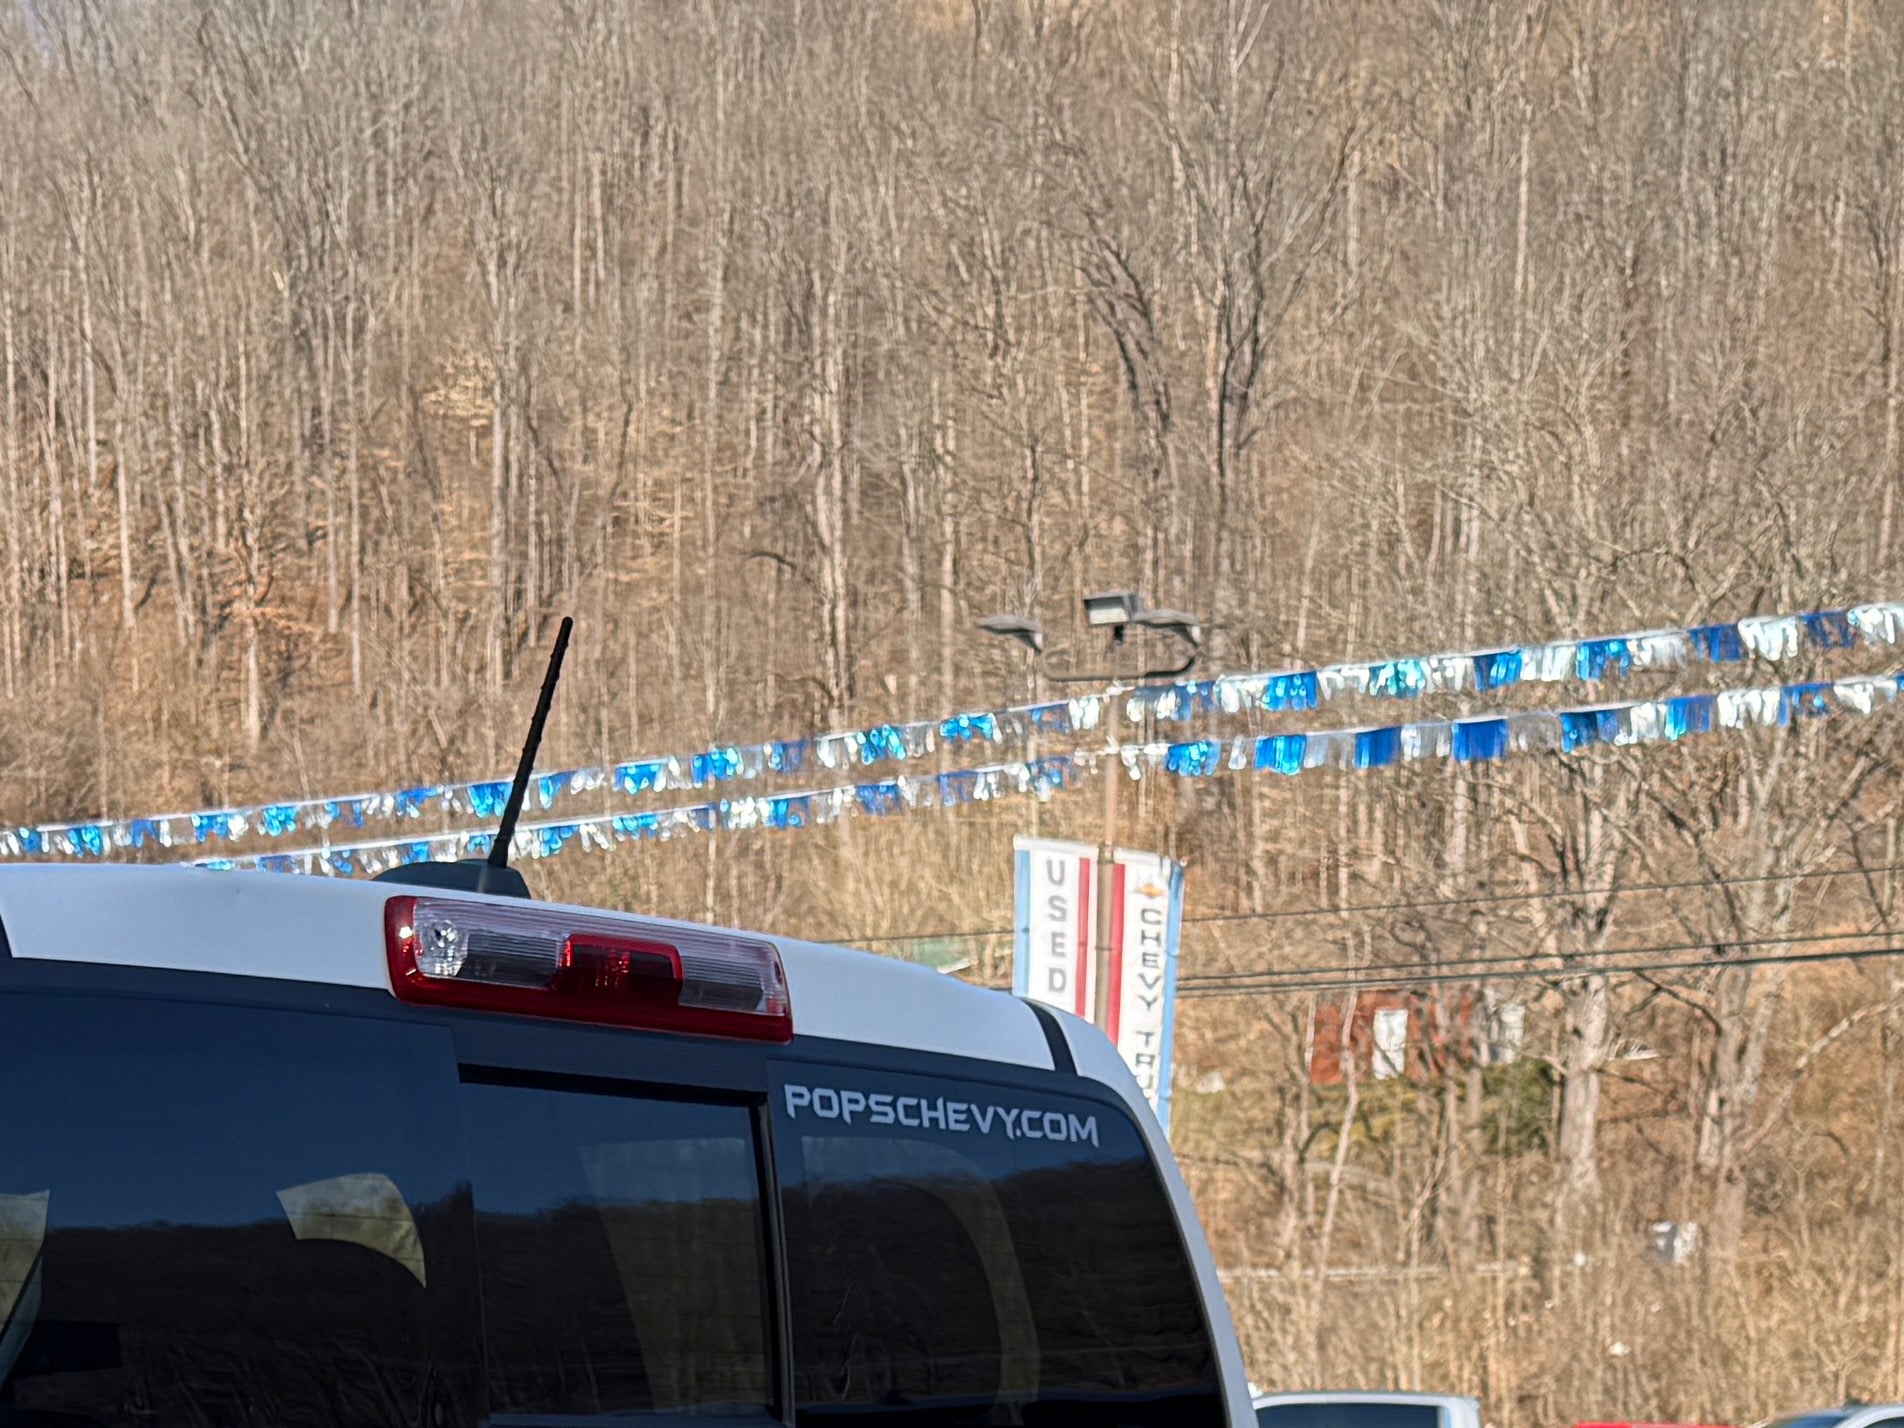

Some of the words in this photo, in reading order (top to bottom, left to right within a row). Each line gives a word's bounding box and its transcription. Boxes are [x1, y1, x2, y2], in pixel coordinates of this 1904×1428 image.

[1046, 859, 1067, 993] USED
[1137, 907, 1162, 1012] CHEVY
[784, 1083, 1100, 1148] POPSCHEVY.COM
